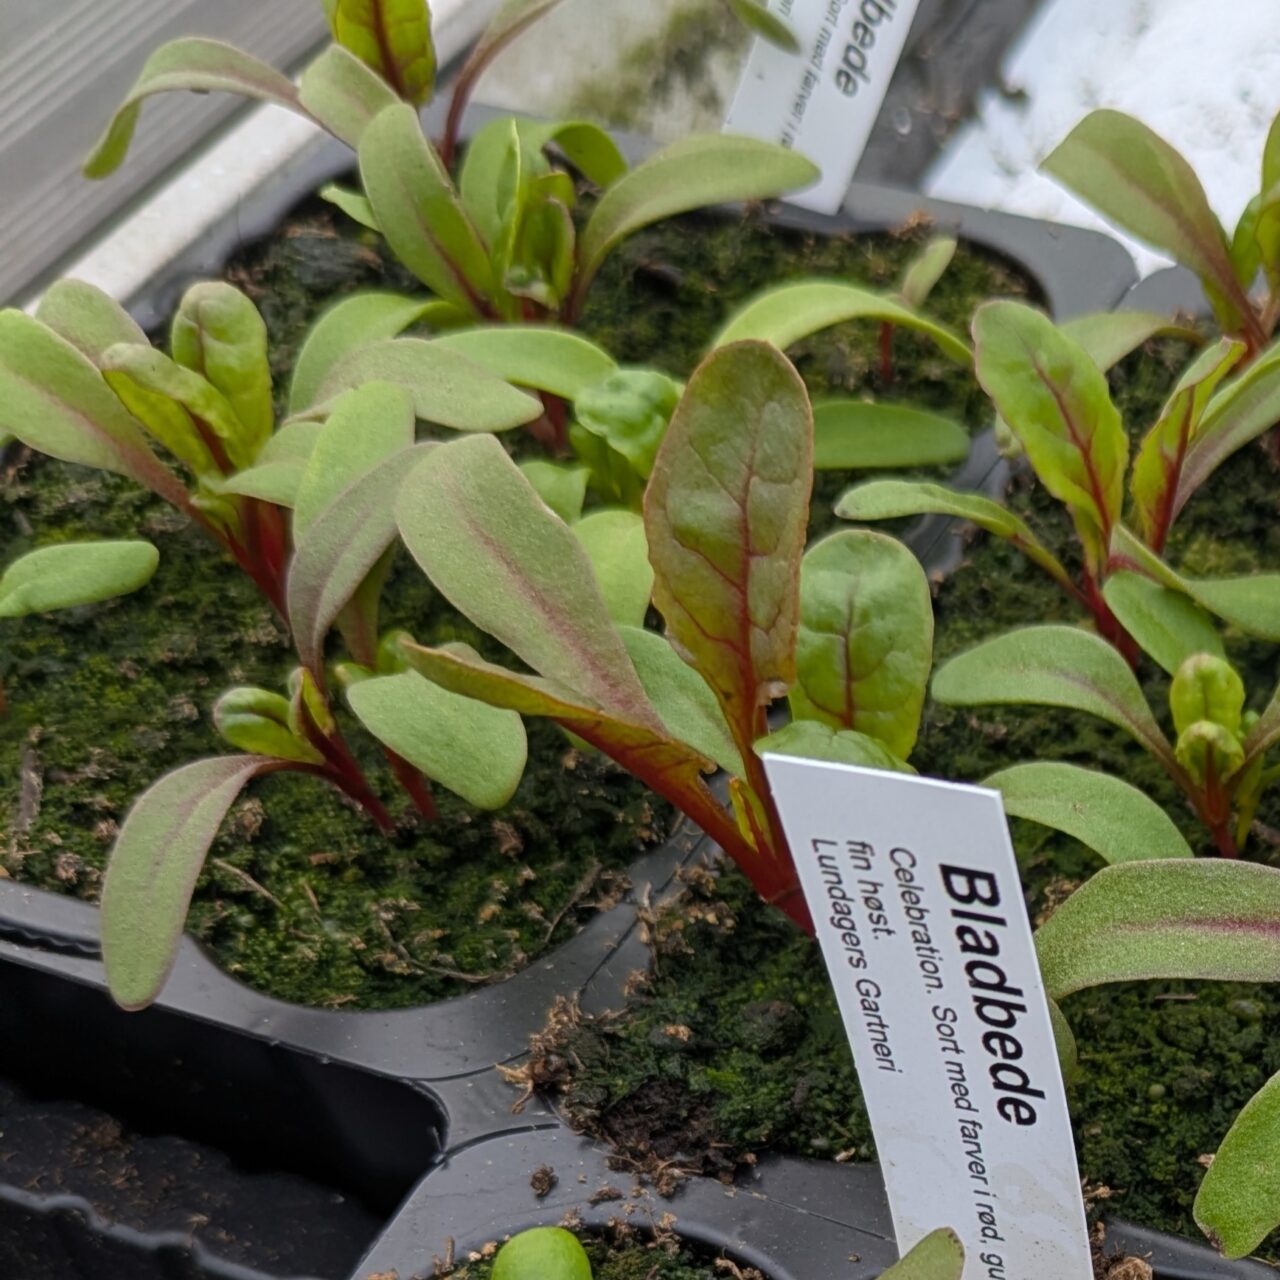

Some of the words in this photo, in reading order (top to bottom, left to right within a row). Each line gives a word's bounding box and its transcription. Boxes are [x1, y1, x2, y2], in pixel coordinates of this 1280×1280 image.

[846, 839, 876, 872] fin
[857, 878, 896, 941] høst.
[888, 847, 945, 995] Celebration.
[811, 837, 868, 970] Lundagers
[855, 977, 904, 1073] Gartneri
[938, 862, 1046, 1127] Bladbede
[932, 1005, 966, 1055] Sort
[945, 1060, 980, 1113] med
[958, 1118, 989, 1187] farver
[973, 1189, 997, 1199] i
[975, 1202, 1005, 1244] rød,
